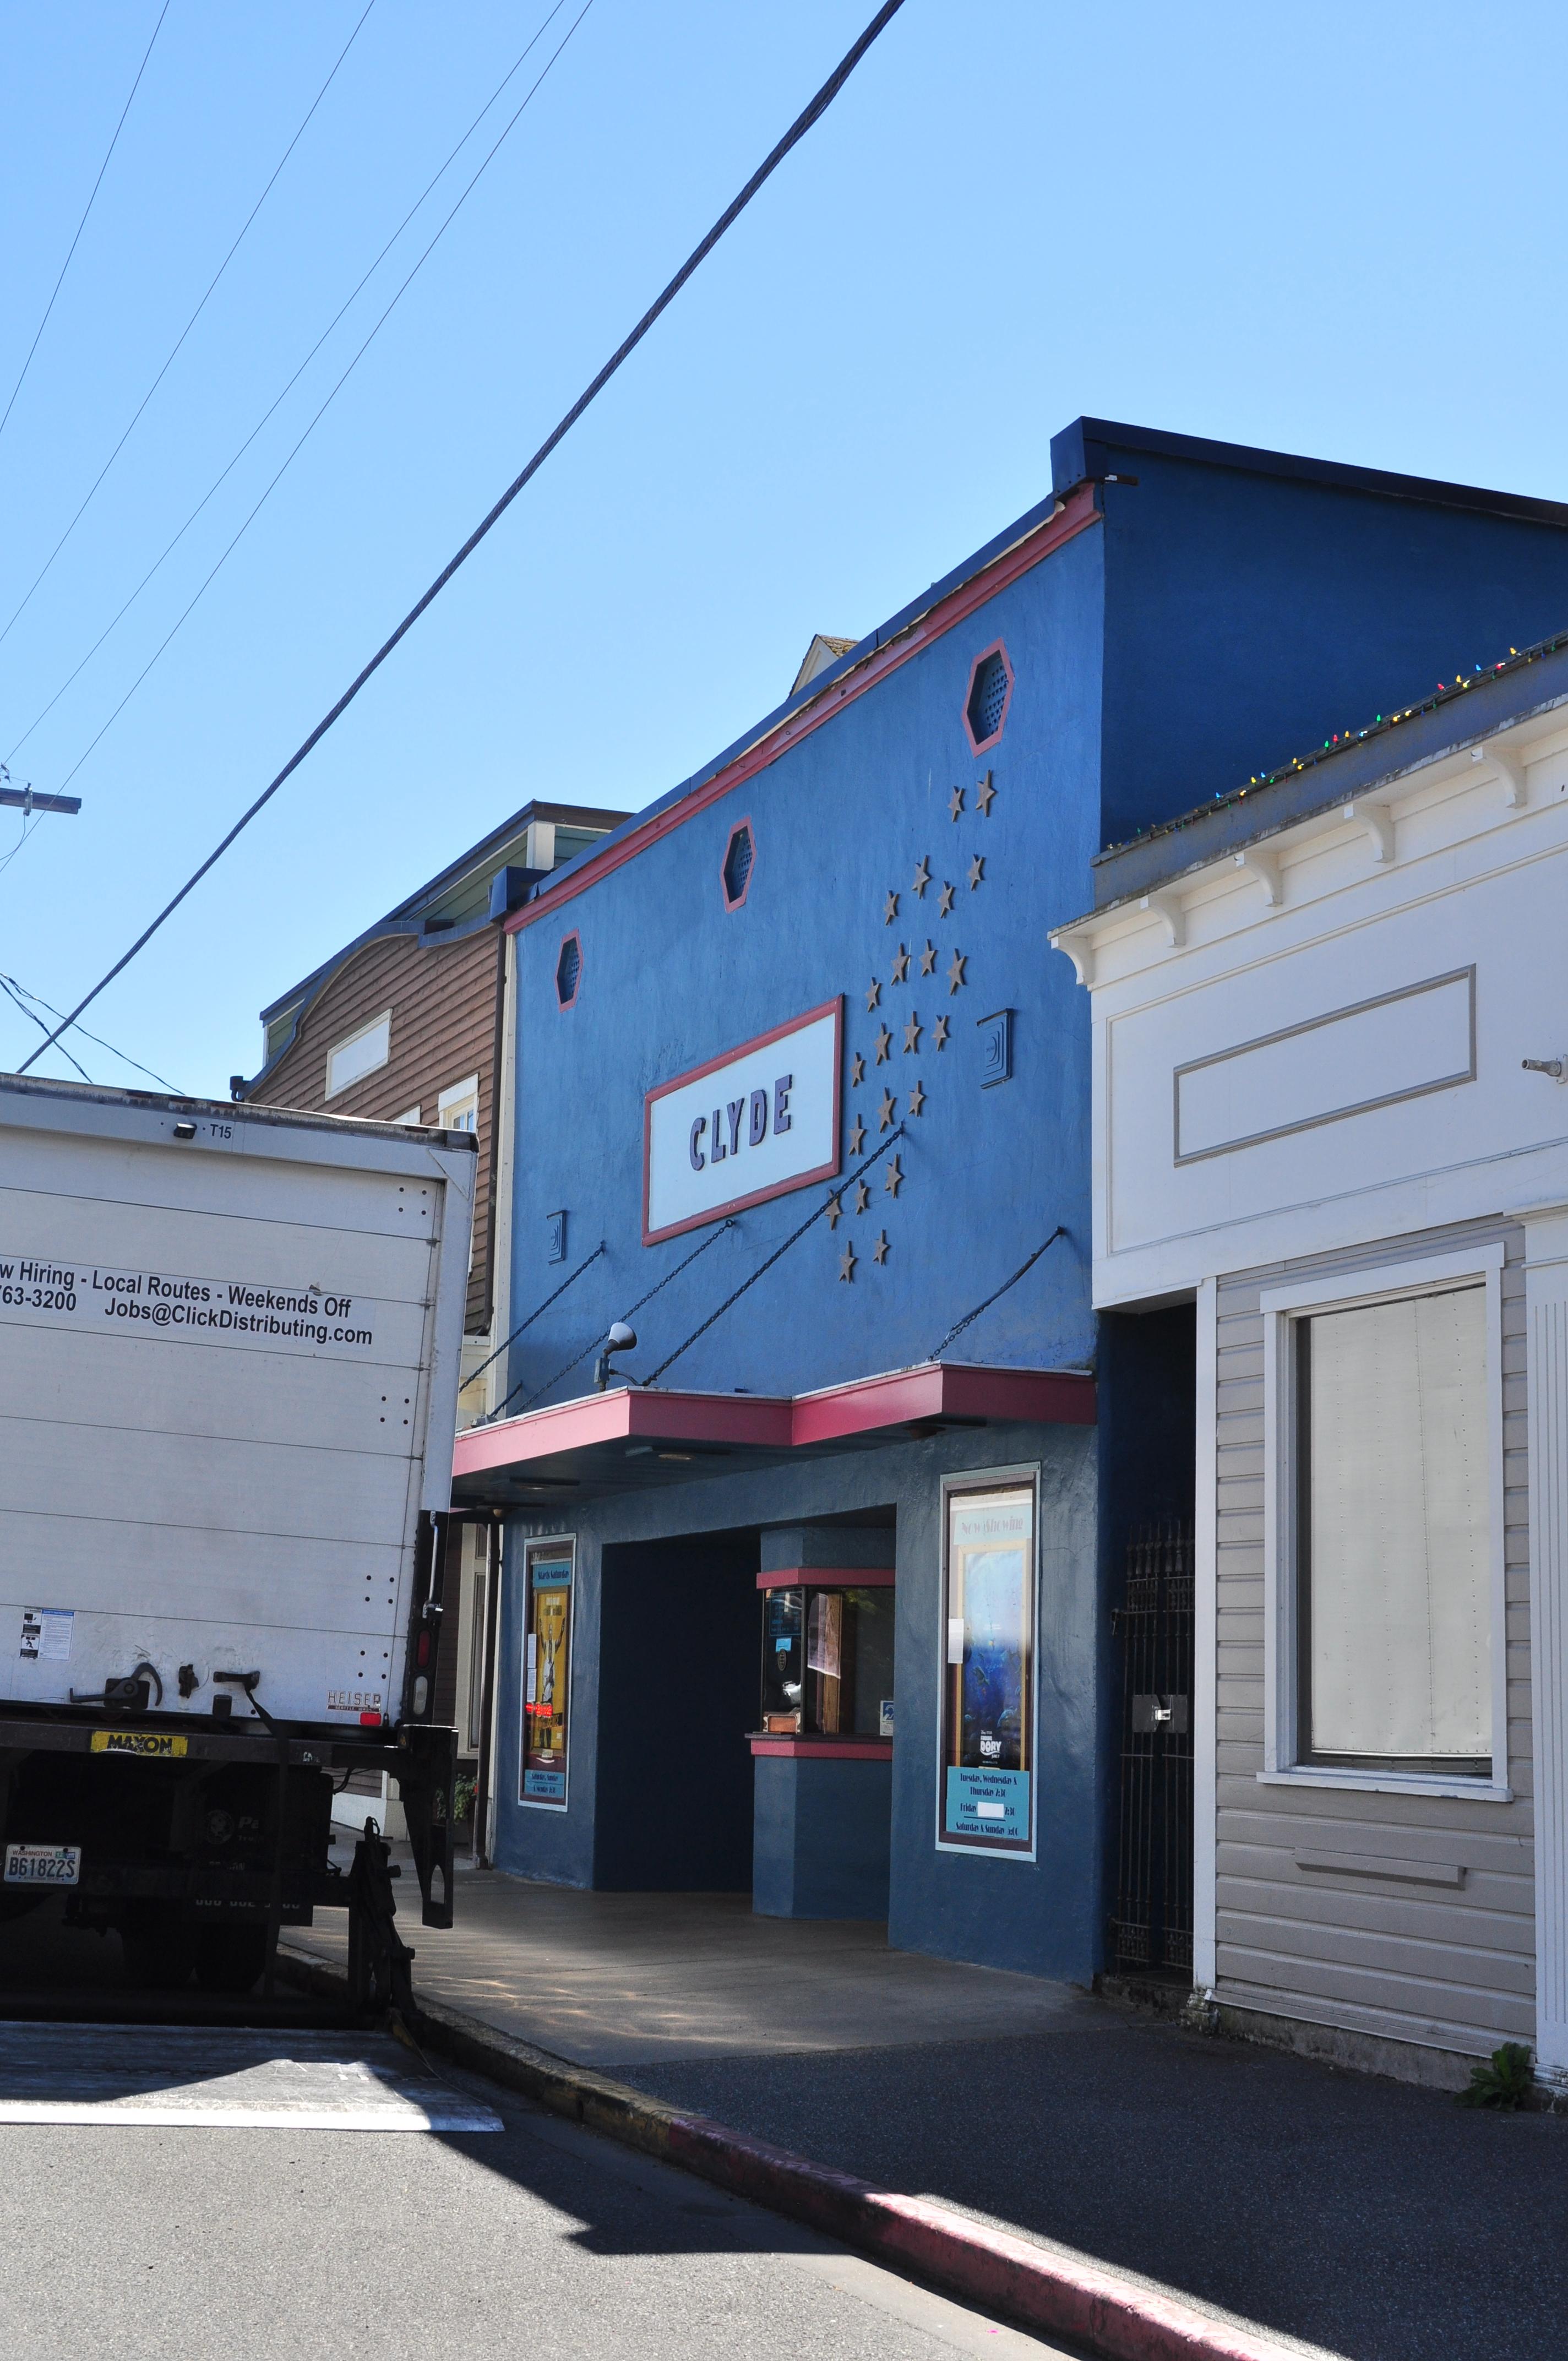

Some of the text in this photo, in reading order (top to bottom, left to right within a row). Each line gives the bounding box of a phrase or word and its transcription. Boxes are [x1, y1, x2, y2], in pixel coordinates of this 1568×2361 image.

[210, 1123, 232, 1139] T15
[689, 1074, 793, 1172] CLYDE
[19, 1261, 75, 1291] Hiring
[92, 1270, 142, 1294] Local
[148, 1276, 210, 1302] Routes
[228, 1285, 318, 1314] Weekends
[324, 1297, 352, 1318] Off
[0, 1285, 373, 1345] 63-3200 Jobs@ClickDistributing.com
[327, 1690, 381, 1706] HEISER
[106, 1734, 173, 1754] MAXON
[980, 1740, 1002, 1753] DORY
[960, 1773, 982, 1783] Tuesday,
[983, 1774, 1012, 1785] Wednesday
[970, 1786, 994, 1797] Thursday
[960, 1803, 977, 1813] Friday
[956, 1821, 979, 1832] Saturday
[985, 1824, 1005, 1835] Sunday
[9, 1857, 75, 1878] B61822S
